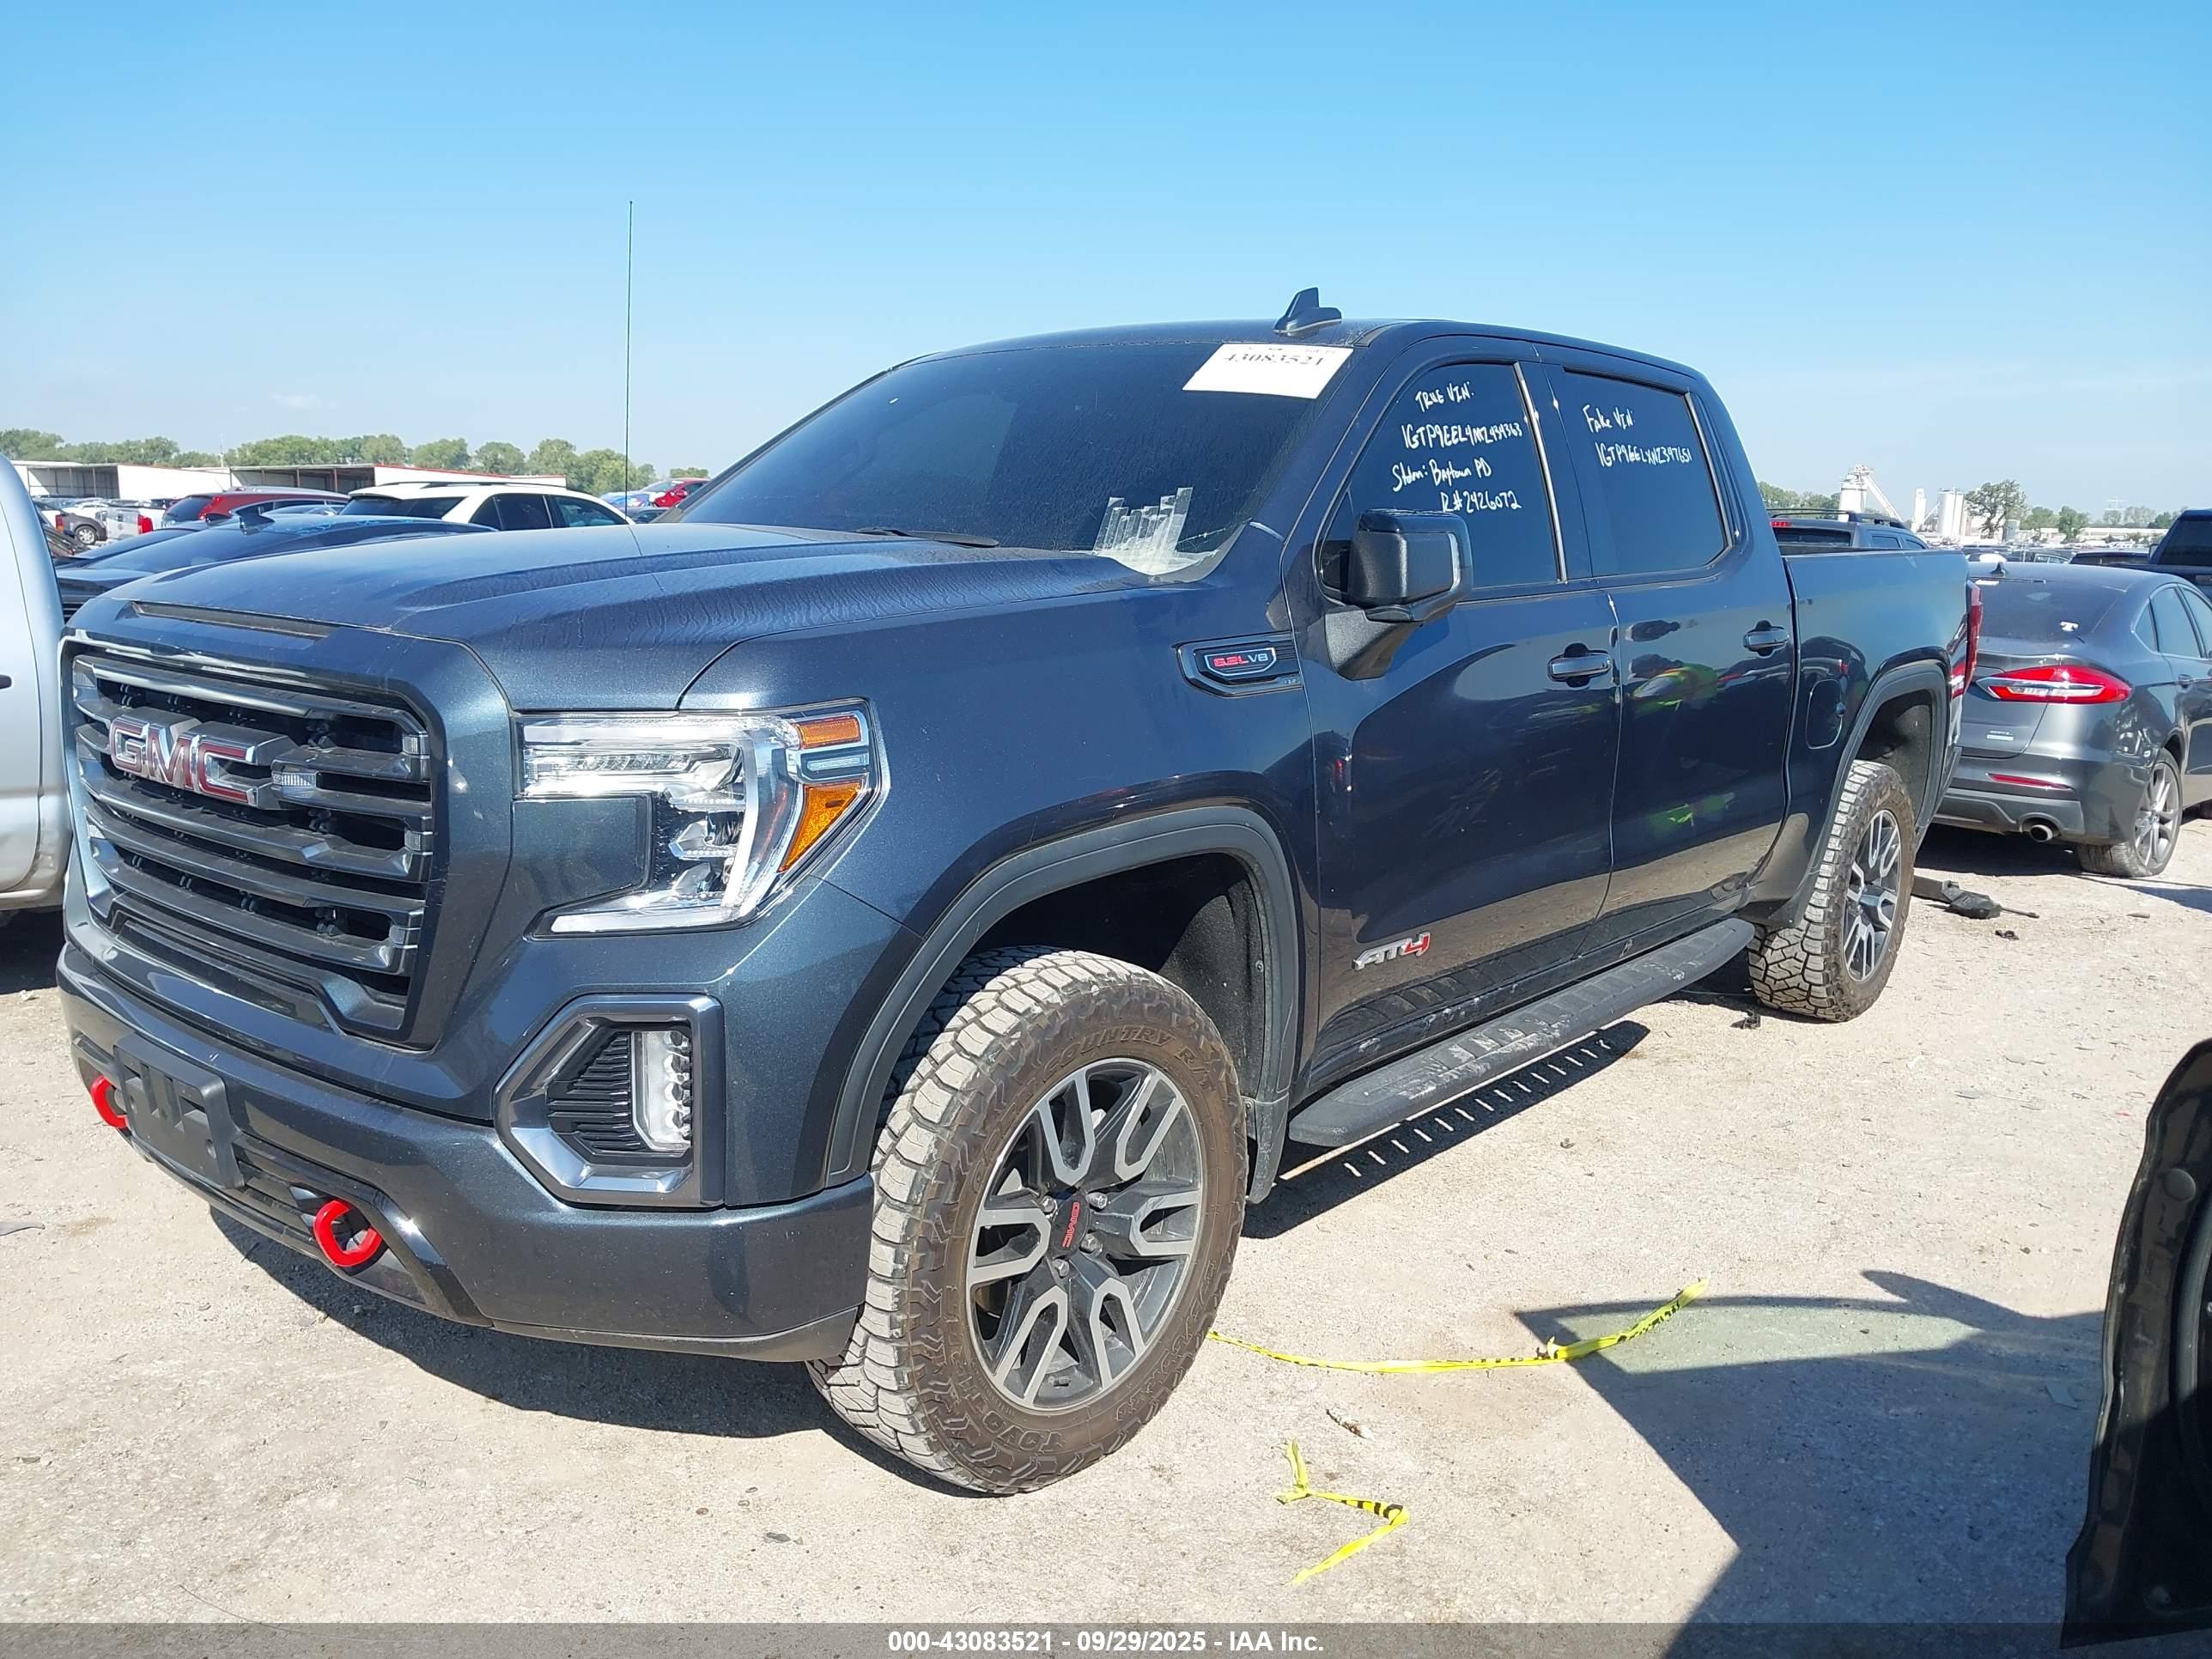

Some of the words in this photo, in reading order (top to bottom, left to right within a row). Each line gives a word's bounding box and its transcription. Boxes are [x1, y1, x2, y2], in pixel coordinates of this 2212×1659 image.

[1224, 352, 1324, 367] 43083521
[1415, 389, 1444, 412] TRUE
[1583, 404, 1613, 433] Fake
[1474, 457, 1492, 478] PD
[1248, 653, 1269, 663] V8
[110, 714, 258, 806] GMC
[1043, 1025, 1175, 1077] COUNTRY
